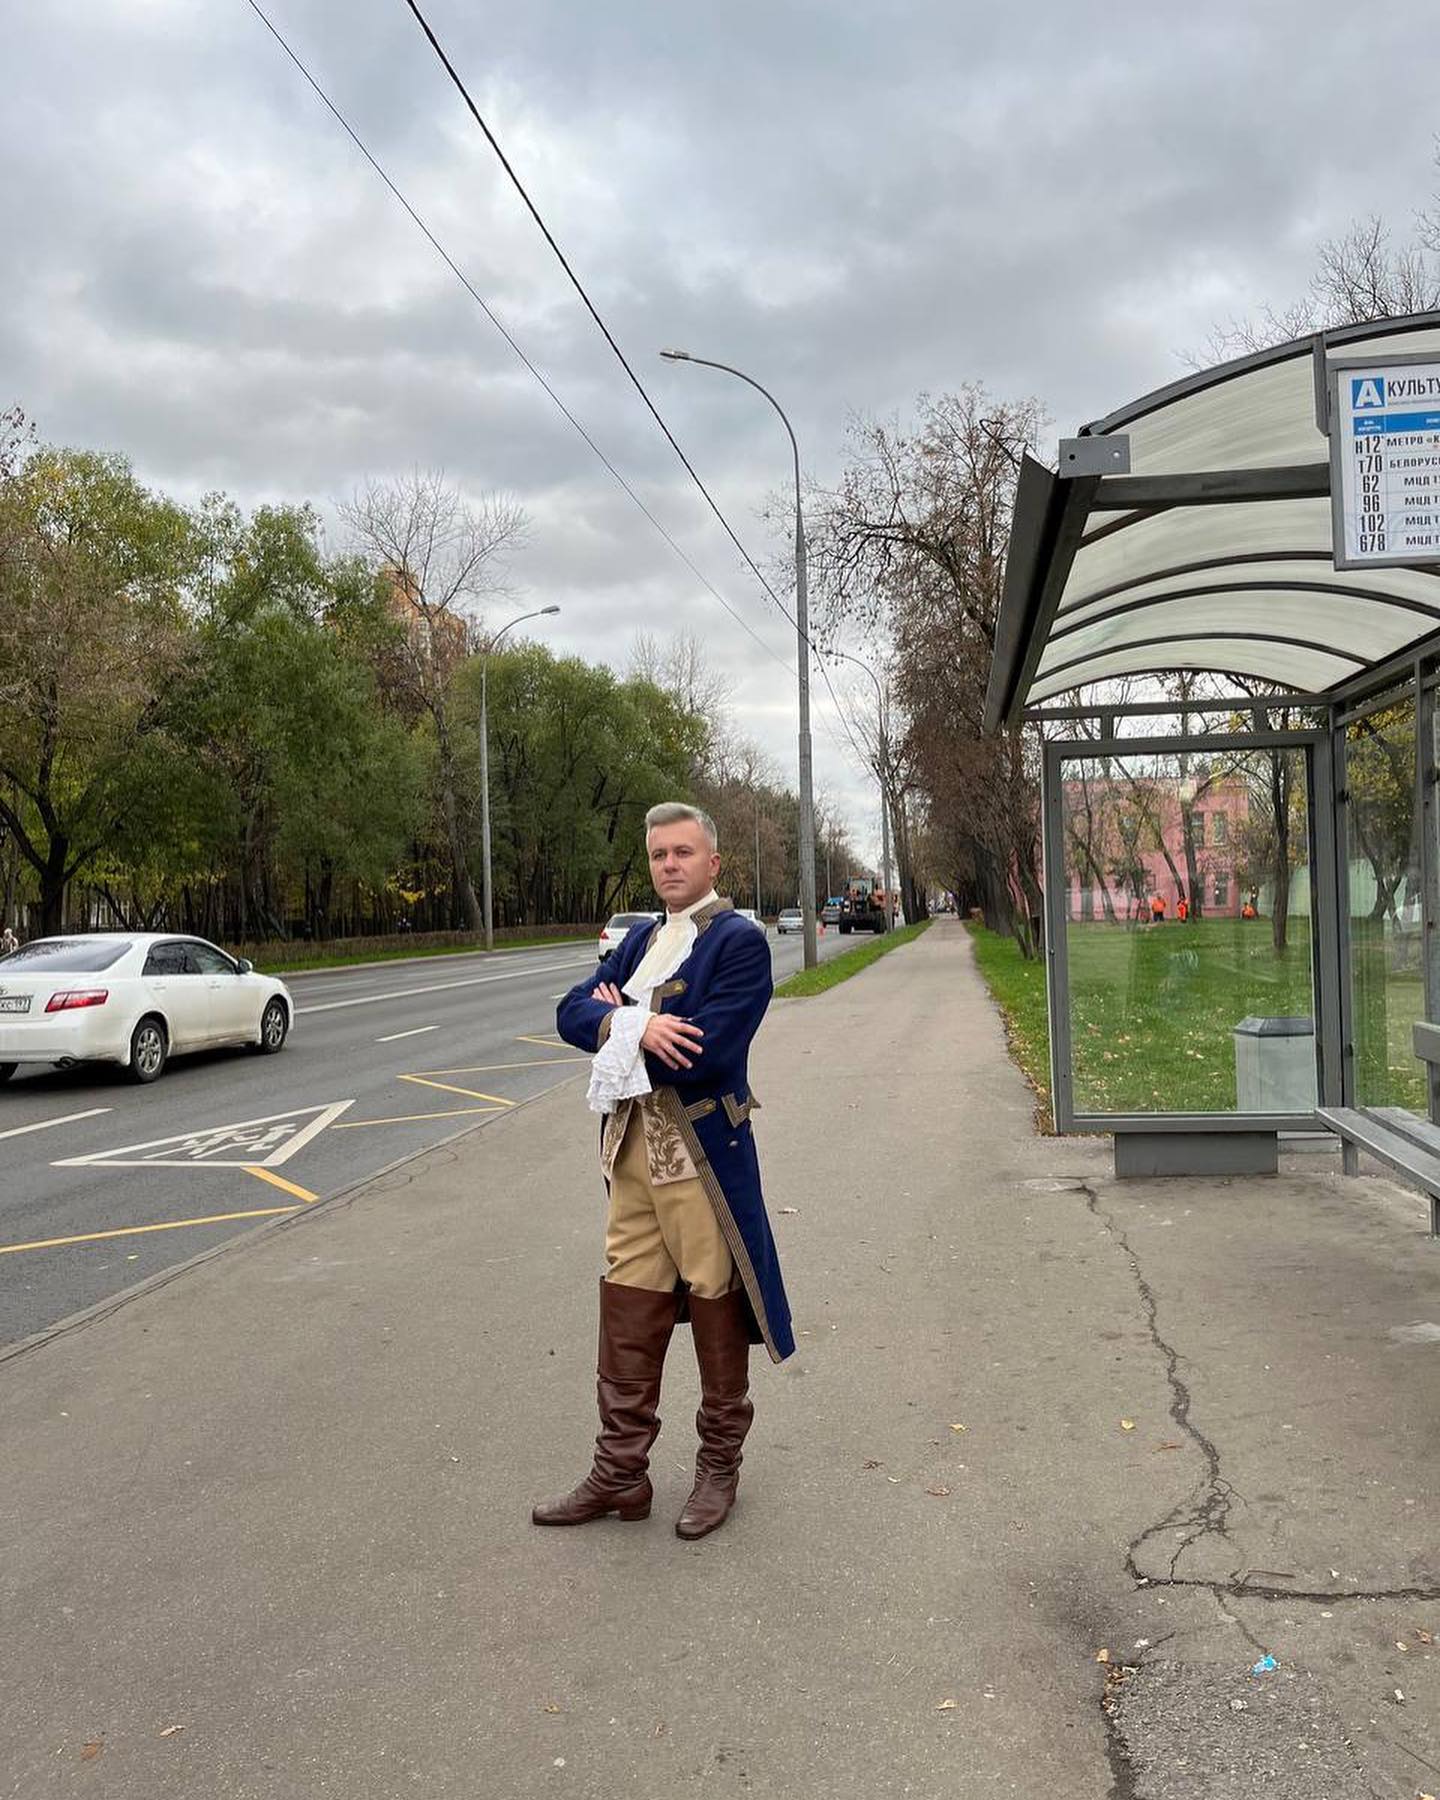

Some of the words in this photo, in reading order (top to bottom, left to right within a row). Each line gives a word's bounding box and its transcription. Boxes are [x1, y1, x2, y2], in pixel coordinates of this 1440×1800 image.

[1387, 435, 1424, 447] МЕТРО
[1389, 456, 1440, 468] БЕЛОРУС
[1362, 474, 1380, 493] 62
[1362, 494, 1380, 513] 96
[1359, 514, 1384, 533] 102
[1359, 533, 1385, 552] 678
